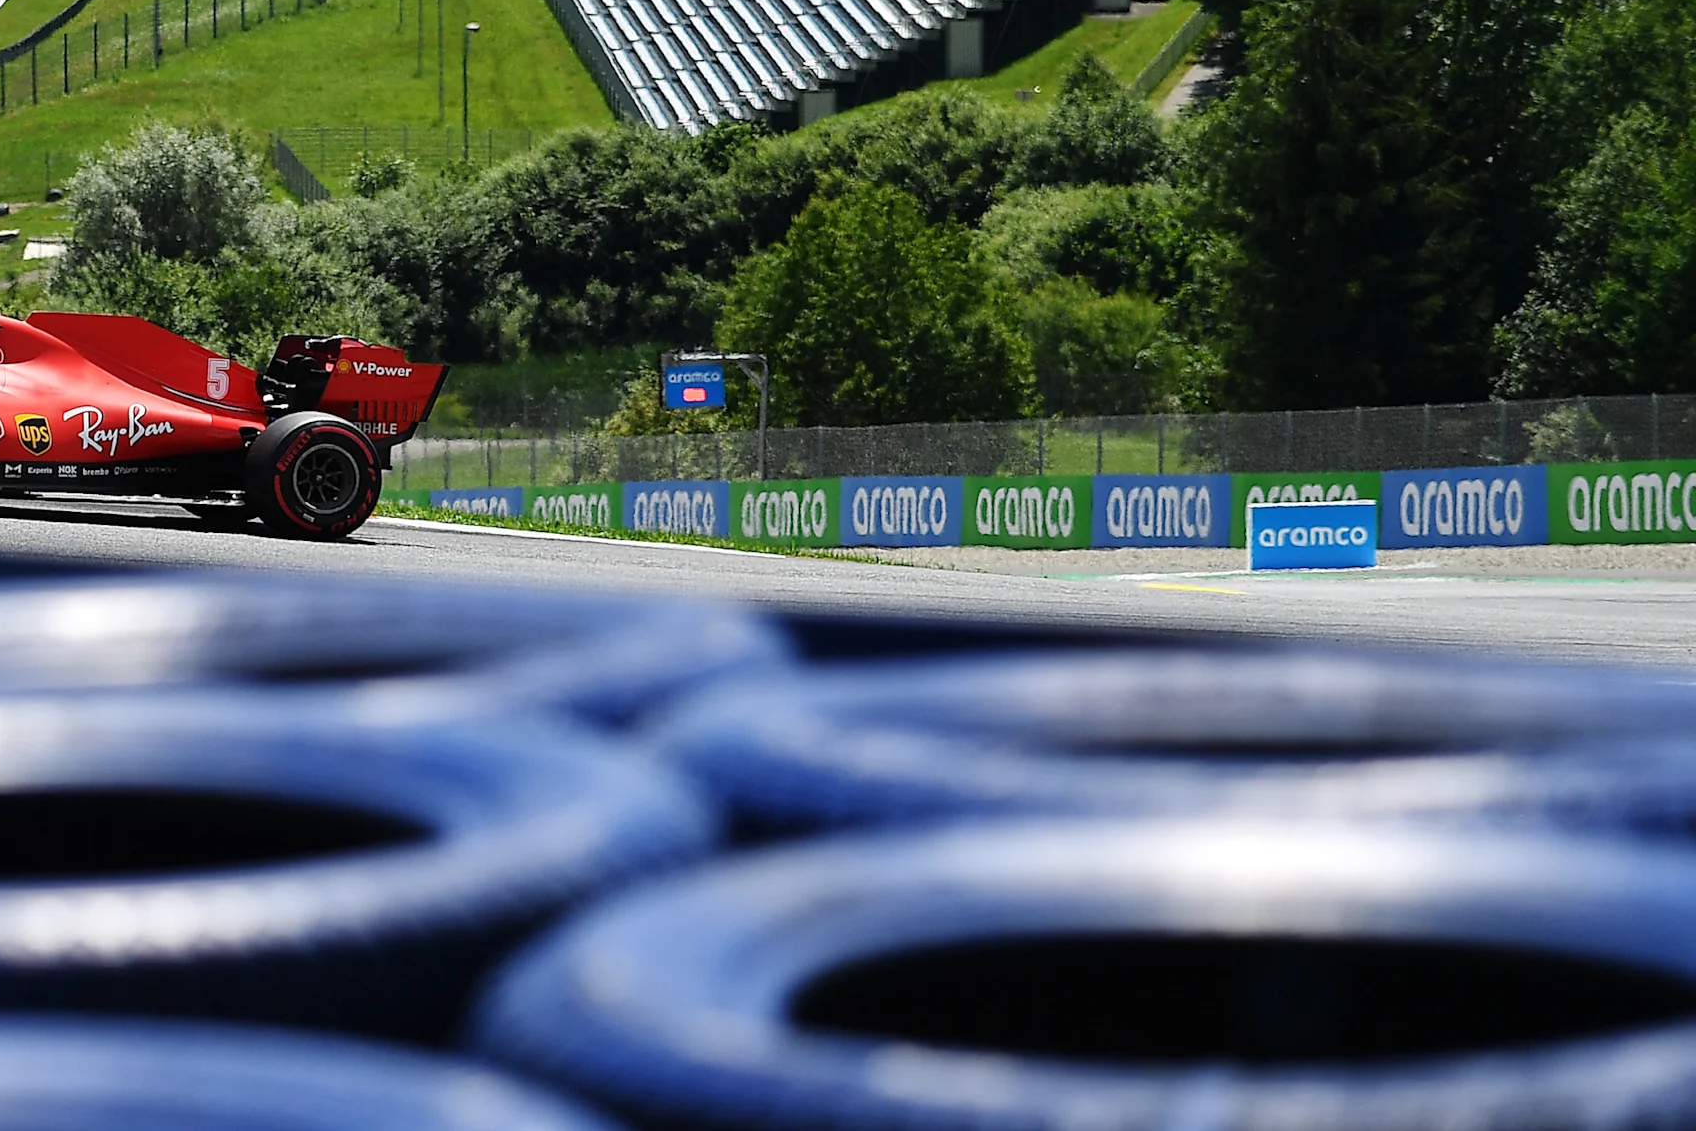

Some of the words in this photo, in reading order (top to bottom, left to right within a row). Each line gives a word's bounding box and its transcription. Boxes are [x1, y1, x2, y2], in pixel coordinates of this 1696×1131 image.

[206, 357, 230, 400] 5
[353, 361, 412, 377] V-Power
[668, 371, 721, 384] aramco
[20, 424, 50, 449] ups
[28, 466, 53, 474] Experis
[82, 467, 110, 476] brembo
[634, 490, 716, 536] aramco
[741, 489, 827, 539] aramco
[852, 486, 947, 536] aramco
[976, 486, 1075, 538] aramco
[1106, 485, 1212, 538] aramco
[1399, 478, 1523, 536] aramco
[1259, 526, 1368, 548] aramco
